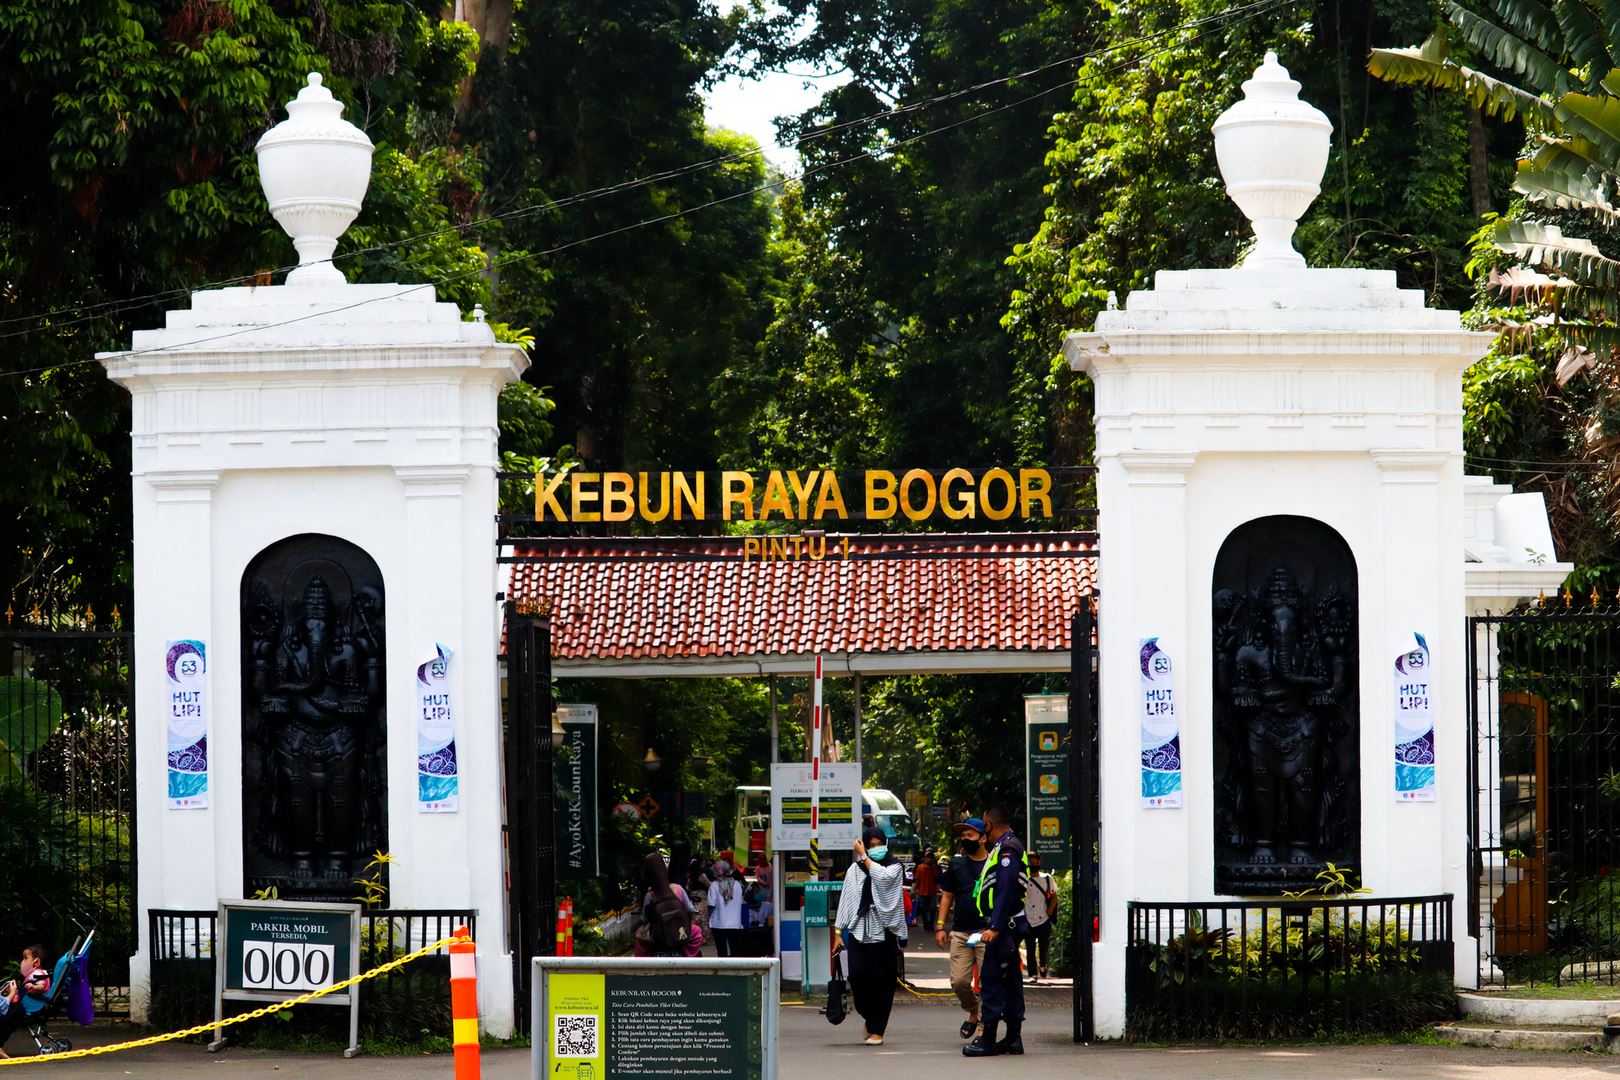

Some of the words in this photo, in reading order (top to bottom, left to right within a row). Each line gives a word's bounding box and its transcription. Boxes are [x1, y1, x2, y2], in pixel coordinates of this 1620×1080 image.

[534, 471, 705, 522] KEBUN
[721, 470, 849, 521] RAYA
[865, 467, 1053, 521] BOGOR
[744, 537, 826, 561] PINTU
[839, 536, 849, 560] 1
[1408, 652, 1424, 665] 53
[181, 660, 197, 673] 53
[1146, 689, 1172, 701] HUT
[1400, 683, 1428, 696] HUT
[173, 691, 201, 703] HUT
[423, 694, 449, 706] HUT
[251, 922, 290, 932] PARKIR
[294, 924, 328, 934] MOBIL
[271, 932, 307, 940] TERSEDIA
[244, 948, 330, 985] 000
